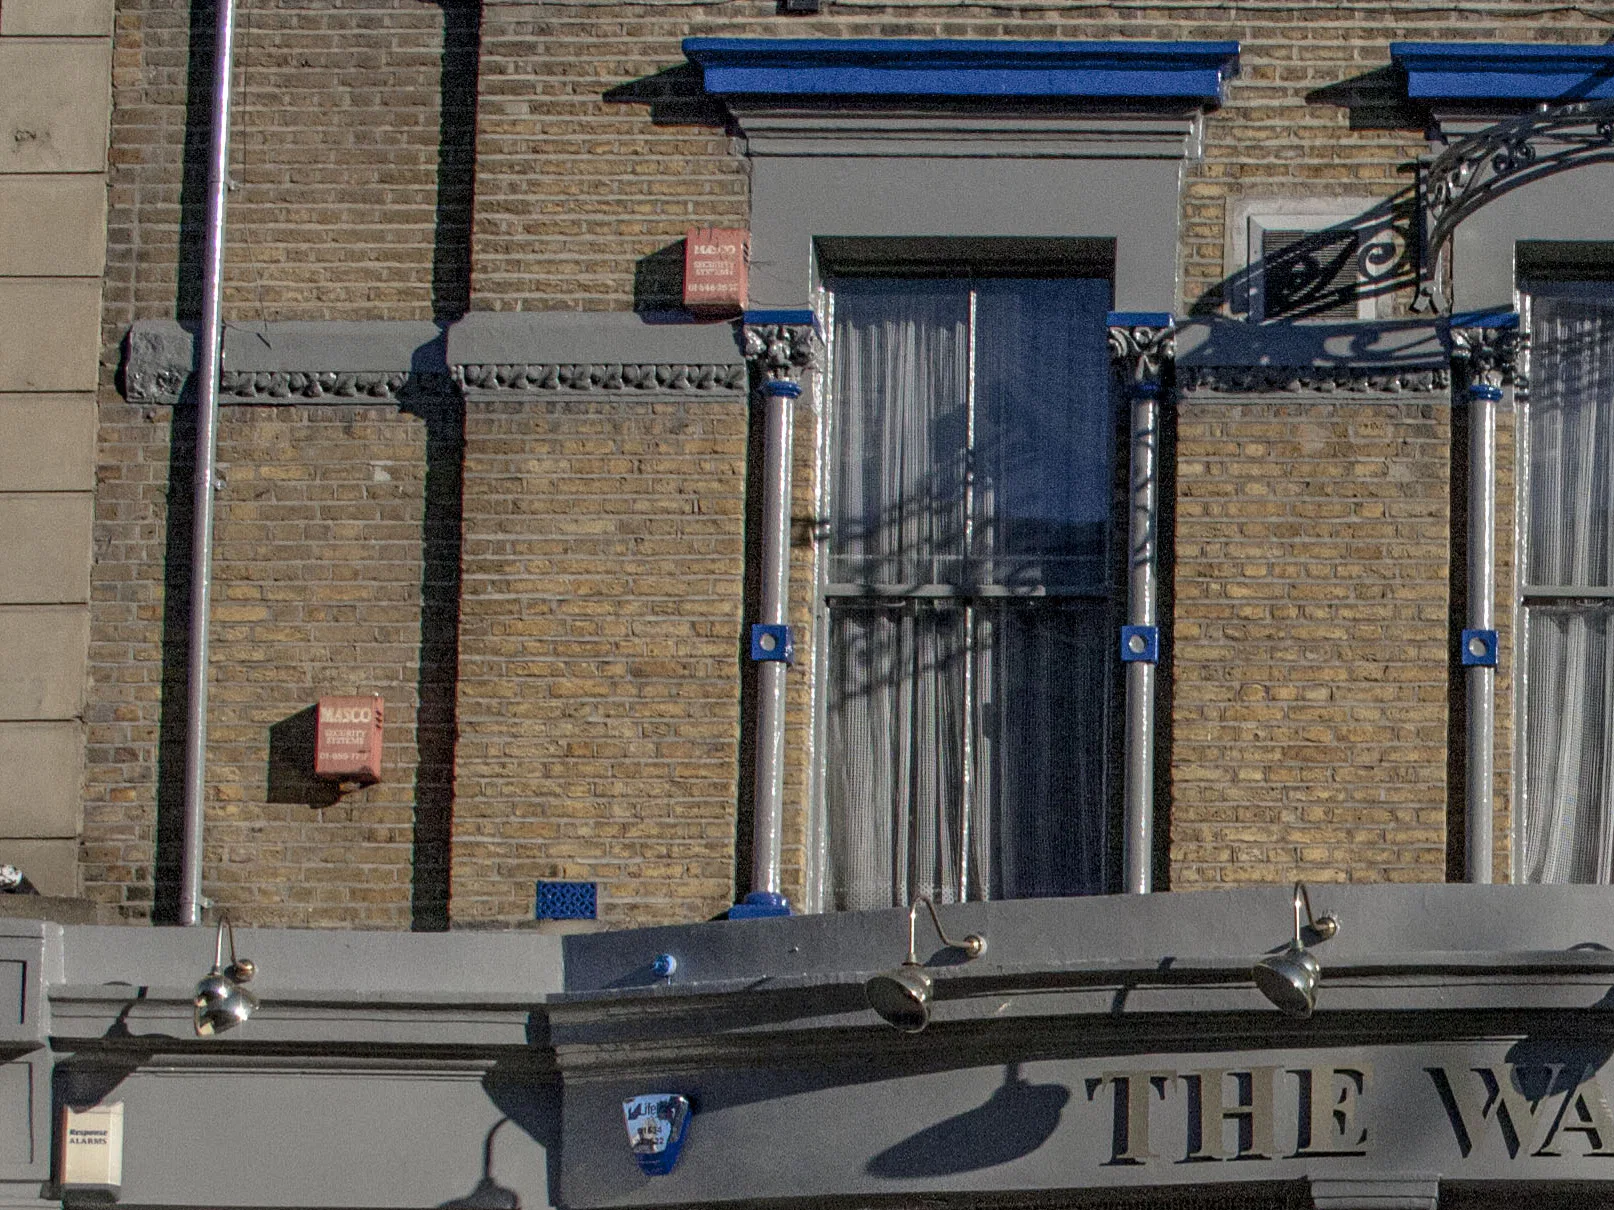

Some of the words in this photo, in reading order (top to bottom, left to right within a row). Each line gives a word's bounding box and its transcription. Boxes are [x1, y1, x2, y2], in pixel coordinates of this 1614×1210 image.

[320, 707, 372, 724] MASCO
[1085, 1062, 1374, 1167] THE
[69, 1128, 108, 1136] Response
